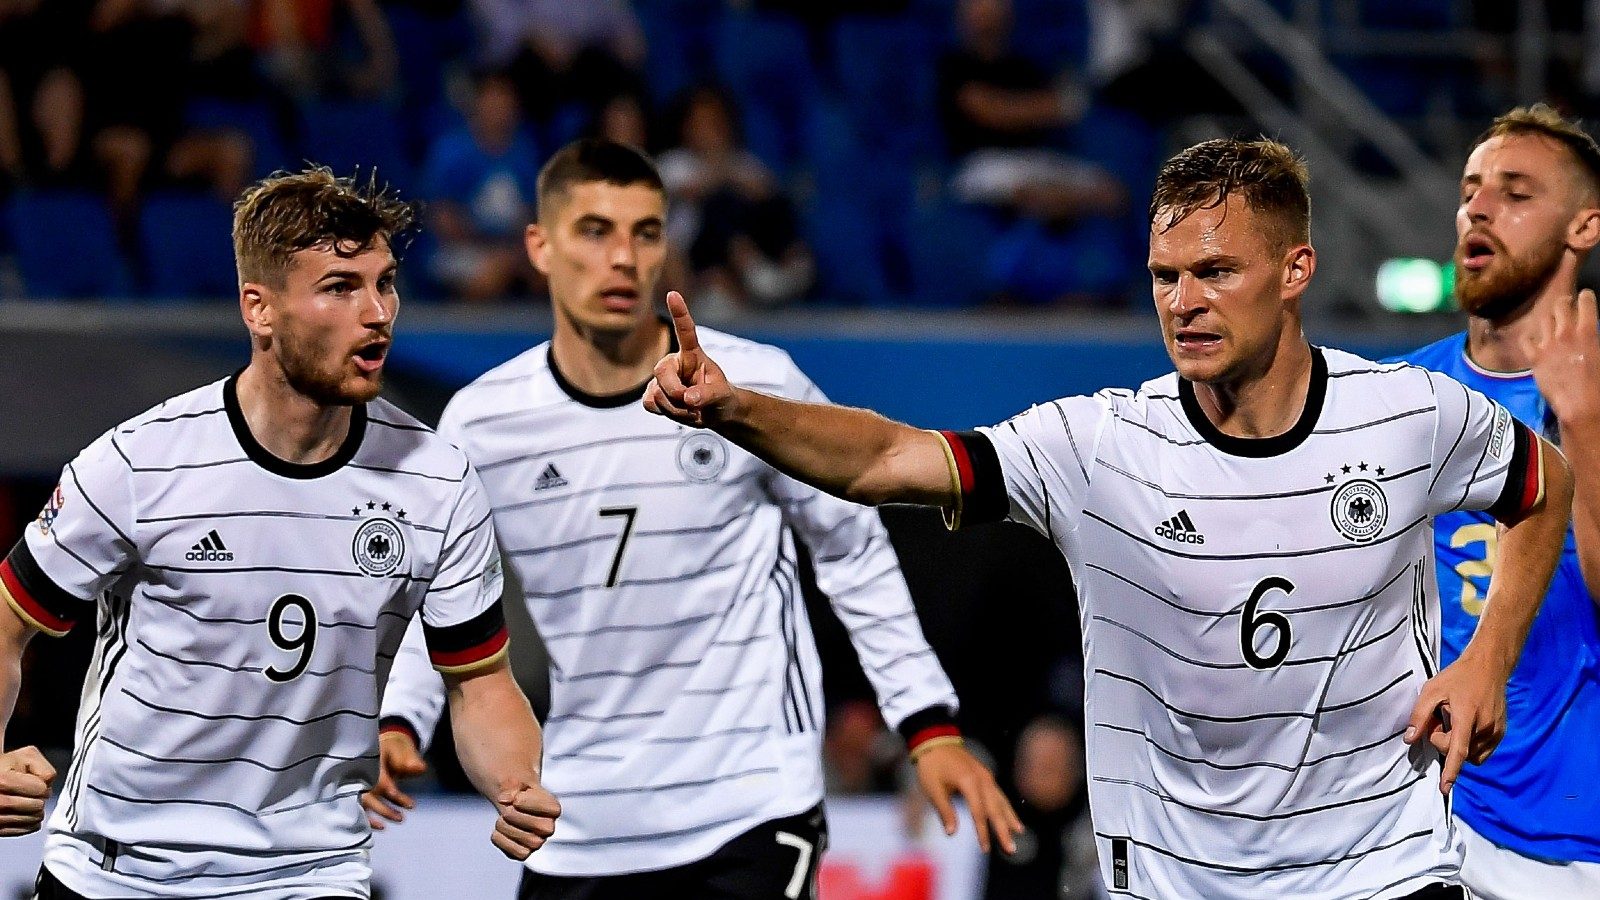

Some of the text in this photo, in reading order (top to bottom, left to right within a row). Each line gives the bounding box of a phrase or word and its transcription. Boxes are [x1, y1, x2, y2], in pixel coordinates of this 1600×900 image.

[1342, 486, 1375, 501] DEUTSCHER
[185, 550, 234, 561] adidas
[599, 507, 637, 588] 7
[1154, 526, 1205, 545] adidas
[263, 593, 317, 683] 9
[1239, 575, 1295, 670] 6
[775, 830, 813, 900] 7
